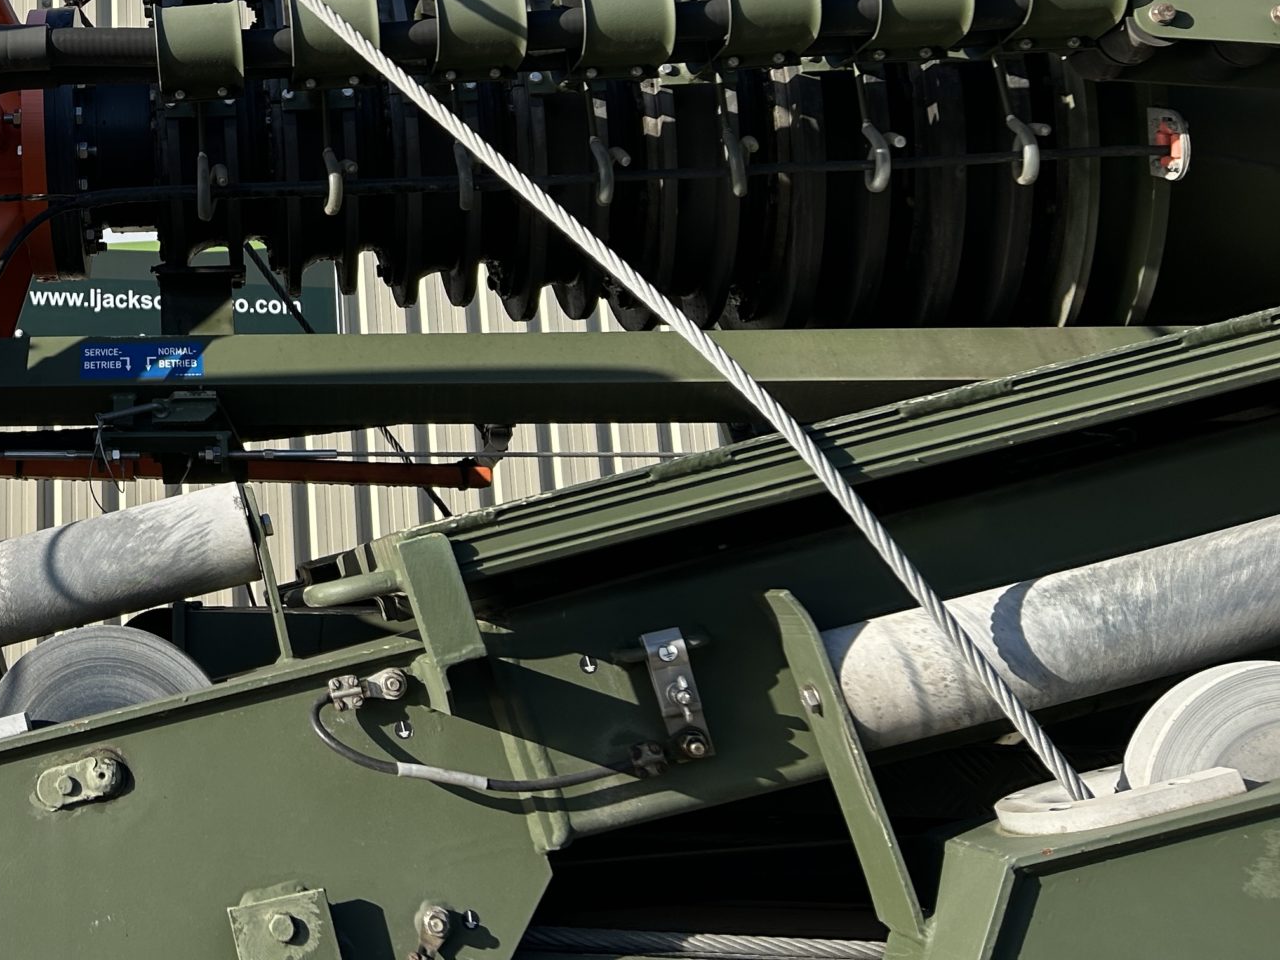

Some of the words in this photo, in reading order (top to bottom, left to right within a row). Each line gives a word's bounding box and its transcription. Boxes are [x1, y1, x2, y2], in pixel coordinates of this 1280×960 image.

[84, 348, 122, 357] SERVICE-
[157, 347, 197, 356] NORMAL-
[84, 360, 122, 370] BETRIEB
[158, 359, 198, 368] BETRIEB
